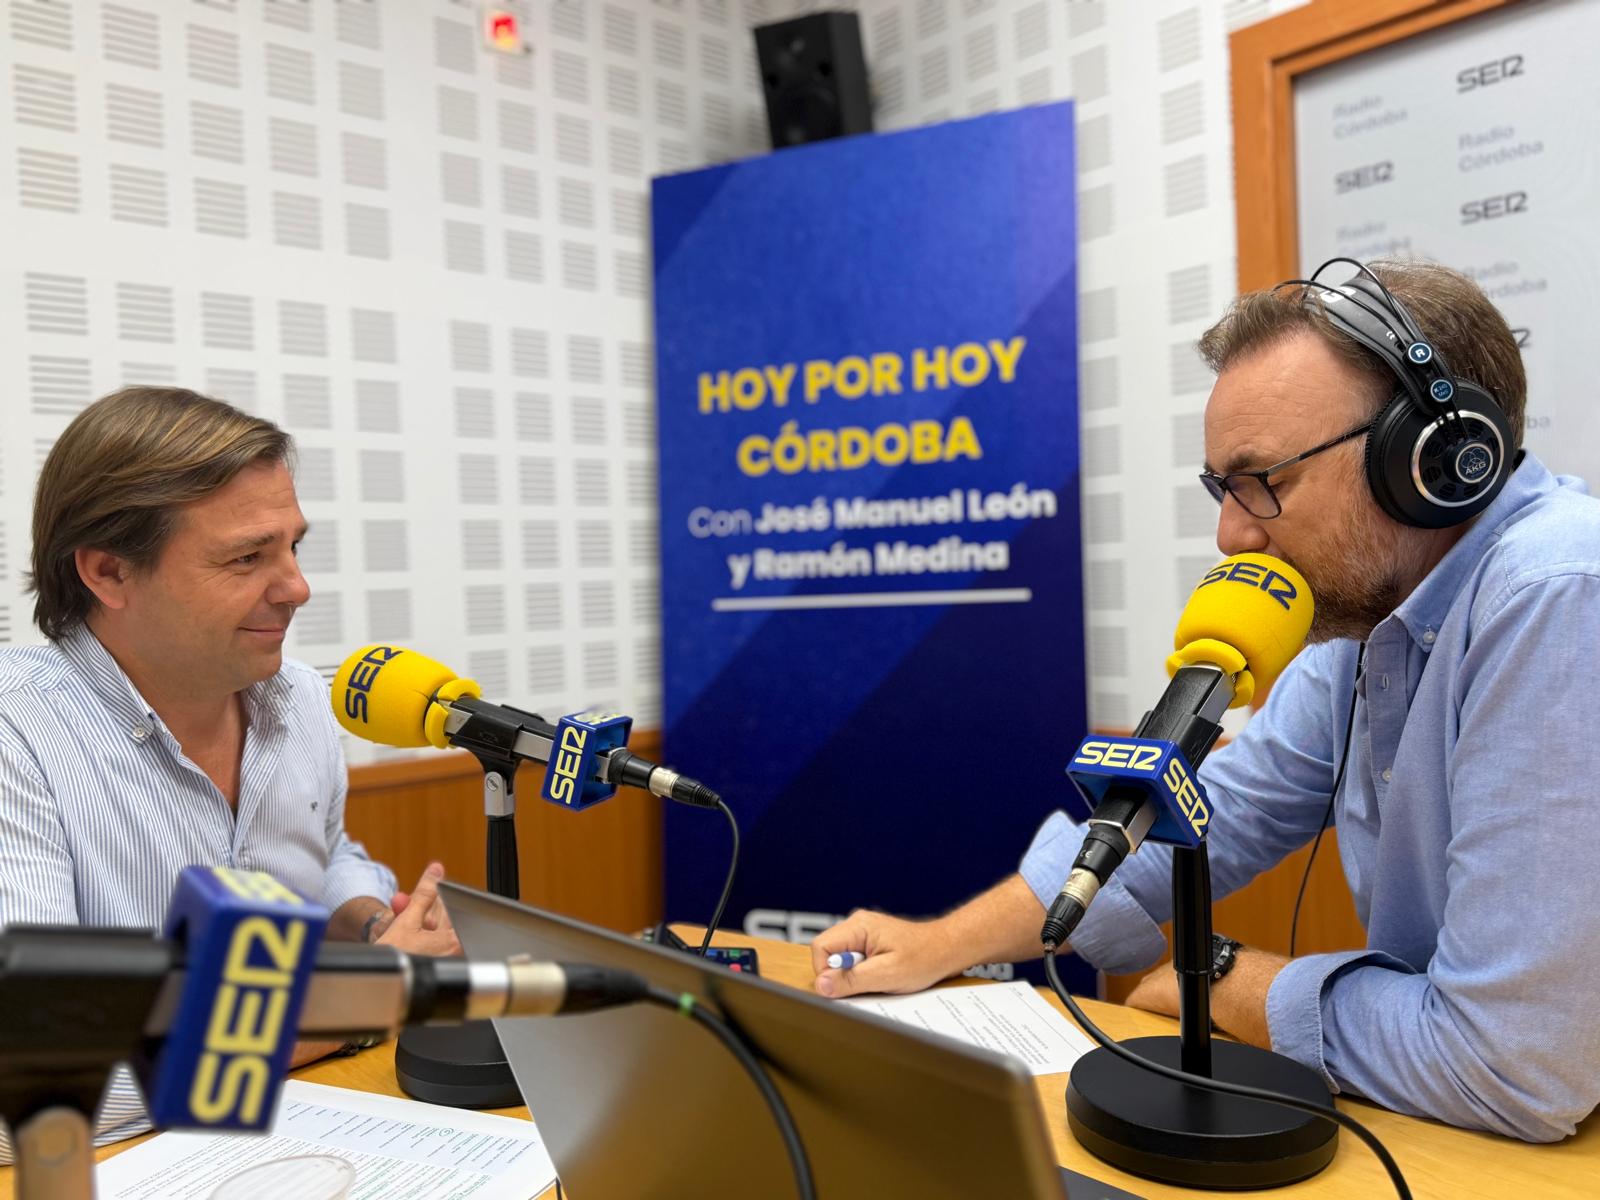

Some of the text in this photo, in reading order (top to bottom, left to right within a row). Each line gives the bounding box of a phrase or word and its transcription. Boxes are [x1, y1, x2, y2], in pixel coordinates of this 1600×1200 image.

[1457, 55, 1524, 93] SER
[1335, 162, 1394, 194] SER
[1460, 191, 1528, 225] SER
[699, 337, 1025, 414] HOY POR HOY
[1414, 347, 1427, 358] R
[737, 417, 983, 476] CÓRDOBA
[1465, 461, 1487, 476] AKG
[688, 482, 1057, 538] Con José Manuel León
[728, 536, 1010, 590] y Ramón Medina
[1197, 562, 1297, 611] SER
[345, 646, 404, 725] SER
[550, 726, 588, 805] SER
[1074, 741, 1163, 771] SER
[1163, 757, 1212, 838] SER
[189, 915, 307, 1125] SER
